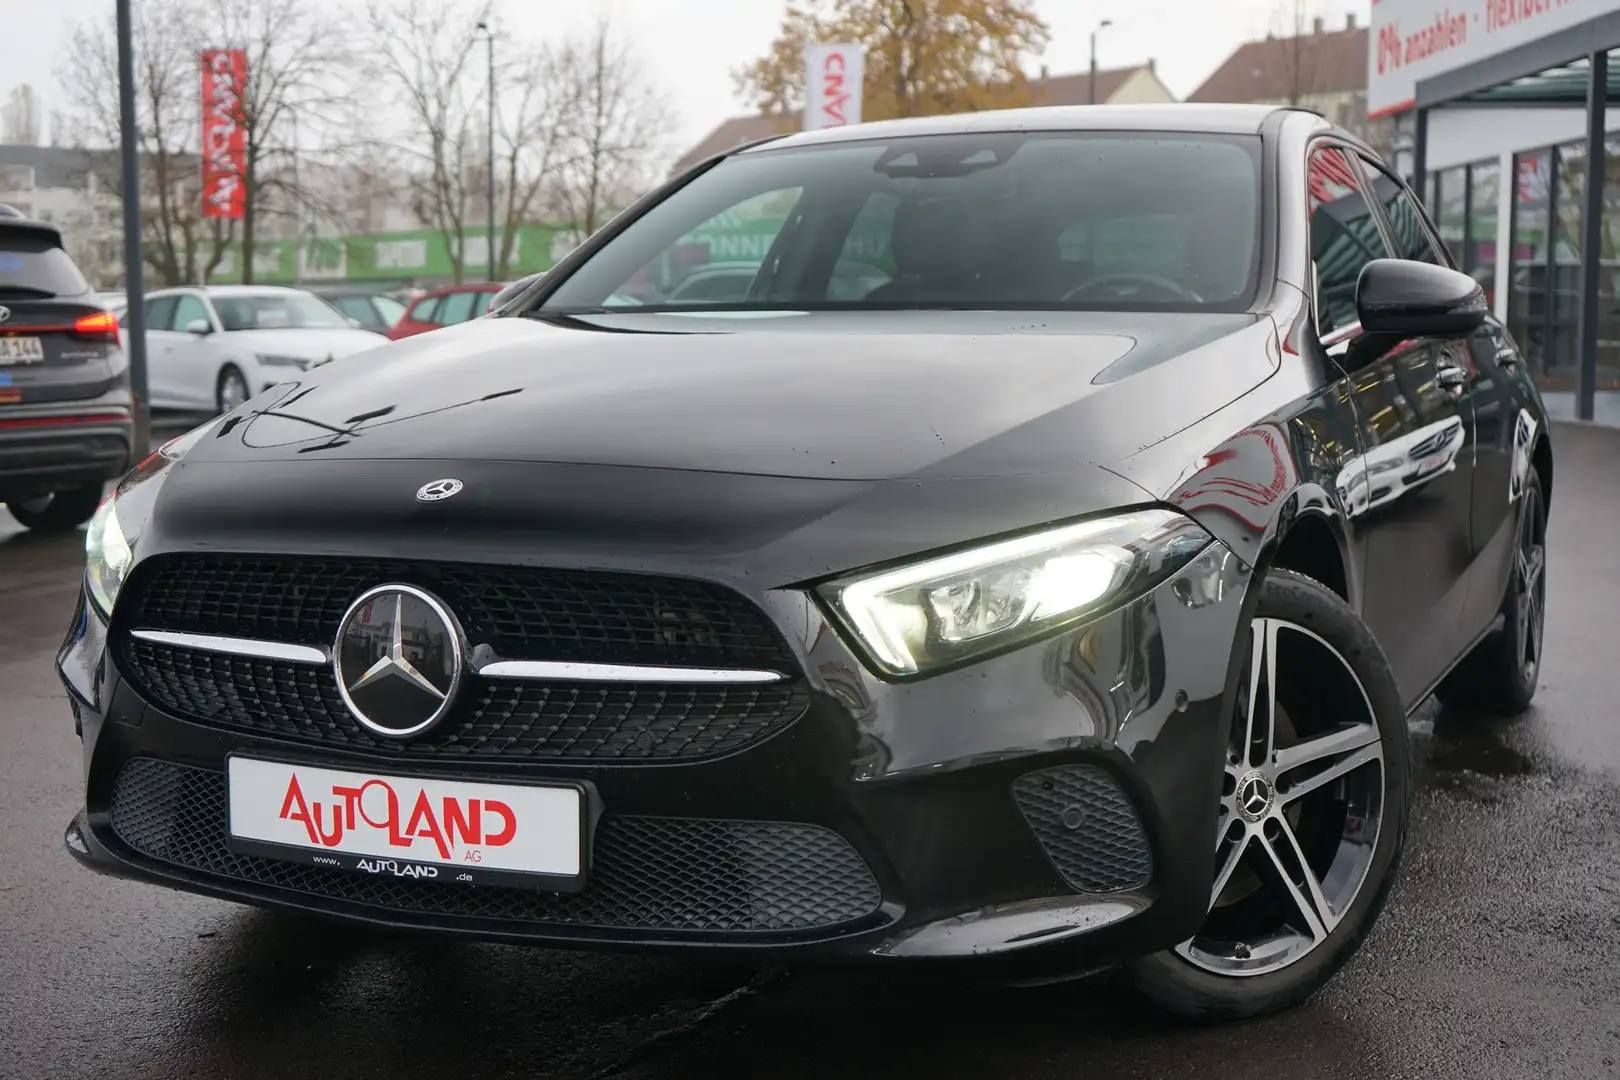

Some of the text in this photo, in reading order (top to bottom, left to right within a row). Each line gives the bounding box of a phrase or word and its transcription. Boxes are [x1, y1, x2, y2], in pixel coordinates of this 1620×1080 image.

[1405, 8, 1467, 65] anzahlen
[13, 339, 39, 357] 144
[279, 772, 517, 859] AUTOLAND
[312, 855, 473, 882] www. AUTOLAND .de
[464, 849, 482, 863] AG
